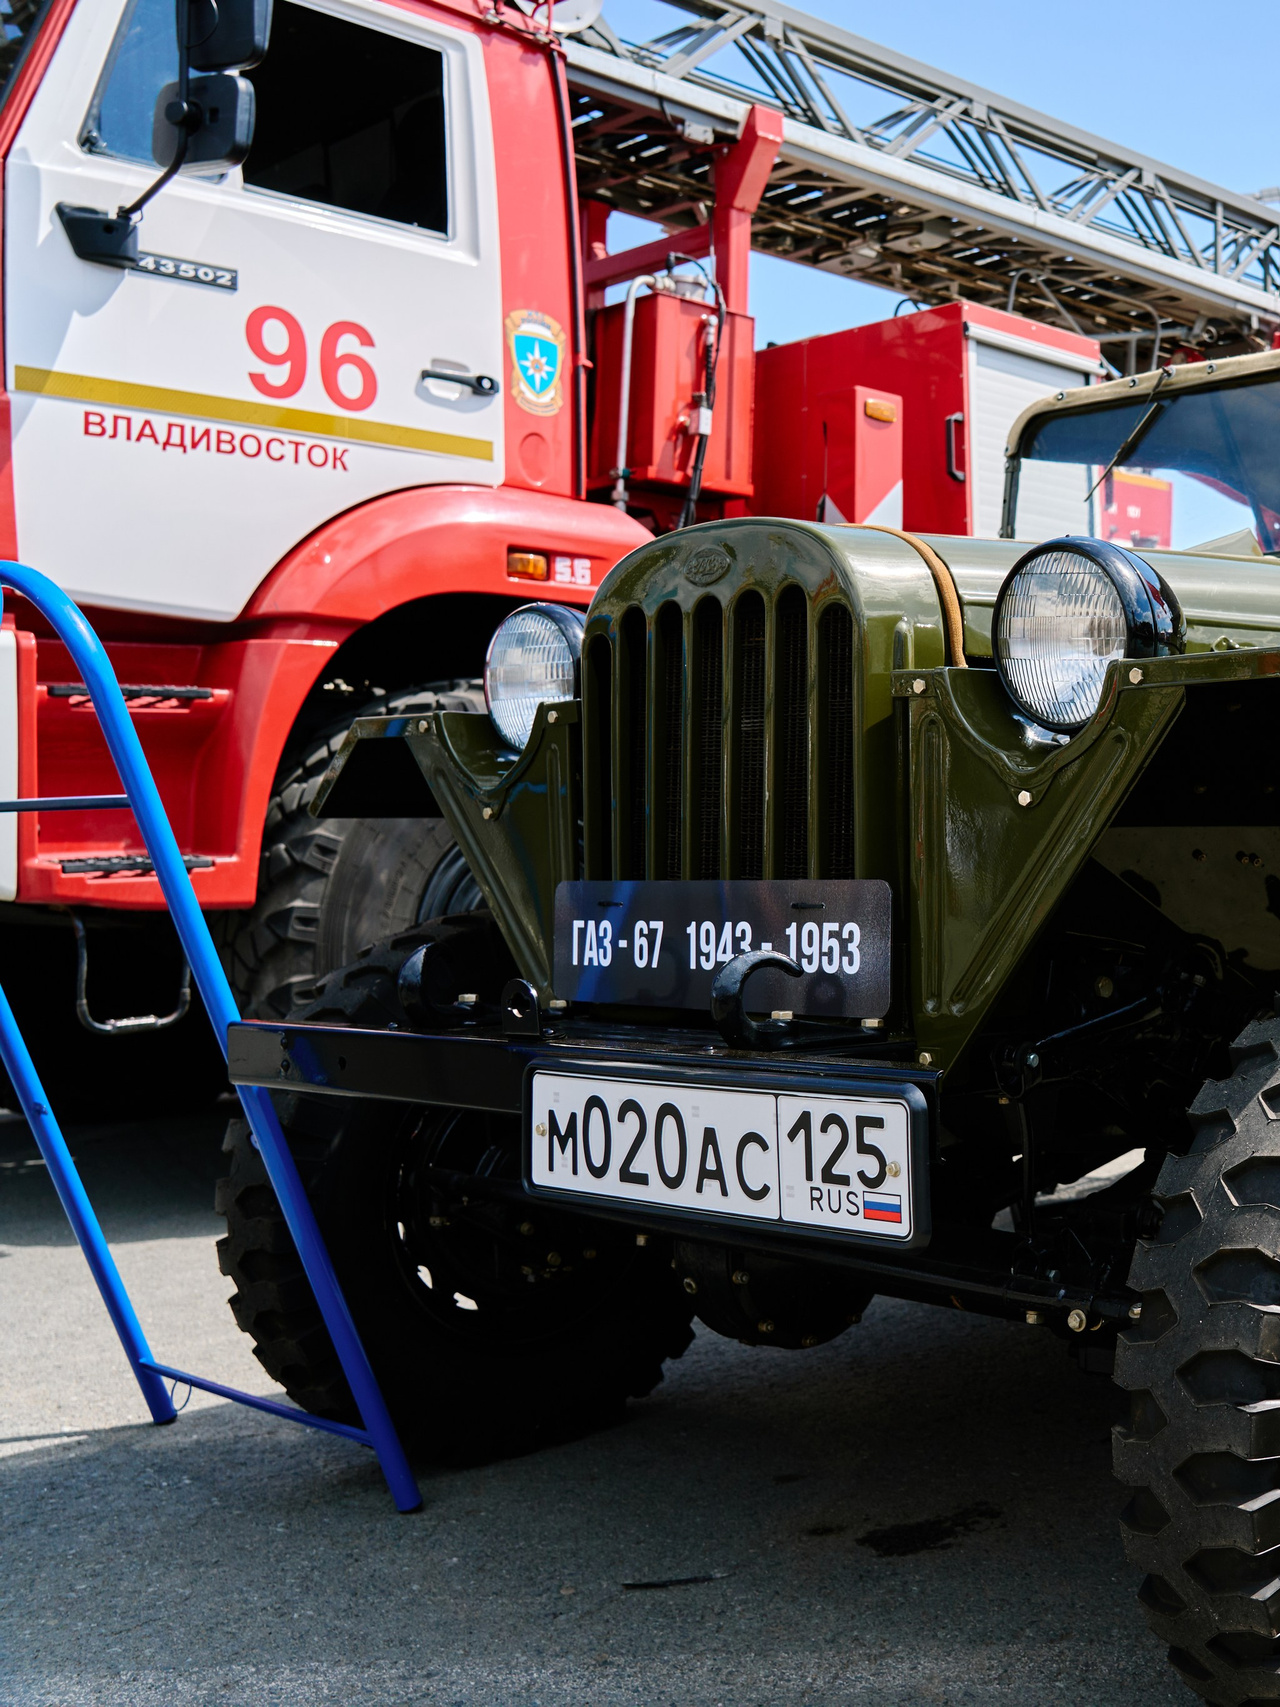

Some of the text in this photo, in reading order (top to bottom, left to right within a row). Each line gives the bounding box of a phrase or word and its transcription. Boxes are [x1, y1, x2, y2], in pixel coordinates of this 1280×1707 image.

[138, 256, 233, 286] 43502
[245, 305, 379, 412] 96
[83, 410, 350, 472] ВЛАДИВОСТОК
[555, 556, 592, 585] 5.6
[686, 920, 752, 971] 1943
[785, 921, 861, 974] 1953
[787, 1109, 888, 1189] 125
[810, 1186, 860, 1216] RUS
